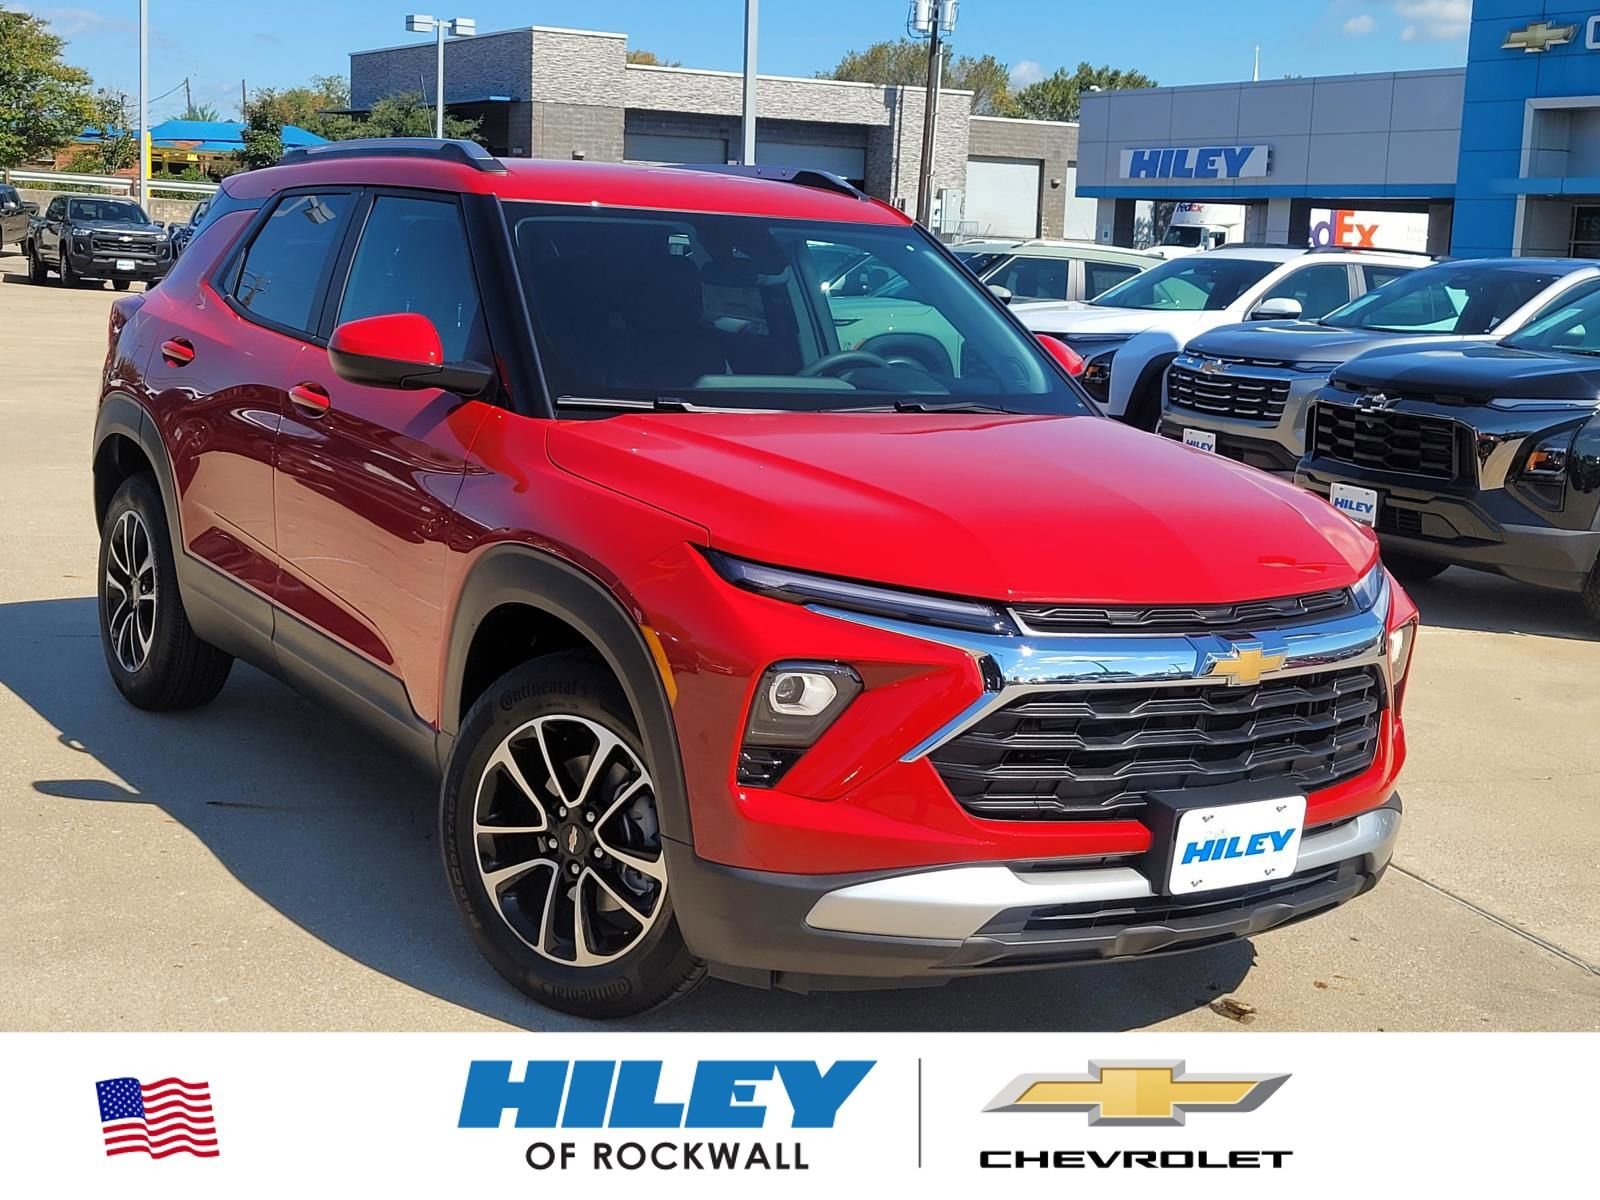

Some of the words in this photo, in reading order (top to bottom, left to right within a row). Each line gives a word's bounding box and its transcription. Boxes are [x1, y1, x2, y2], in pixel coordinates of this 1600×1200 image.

[1129, 147, 1255, 178] HILEY
[1309, 210, 1380, 248] dEx
[1186, 439, 1214, 451] HILEY
[1334, 497, 1374, 514] HILEY
[501, 680, 577, 711] Continental
[1181, 828, 1297, 865] HILEY
